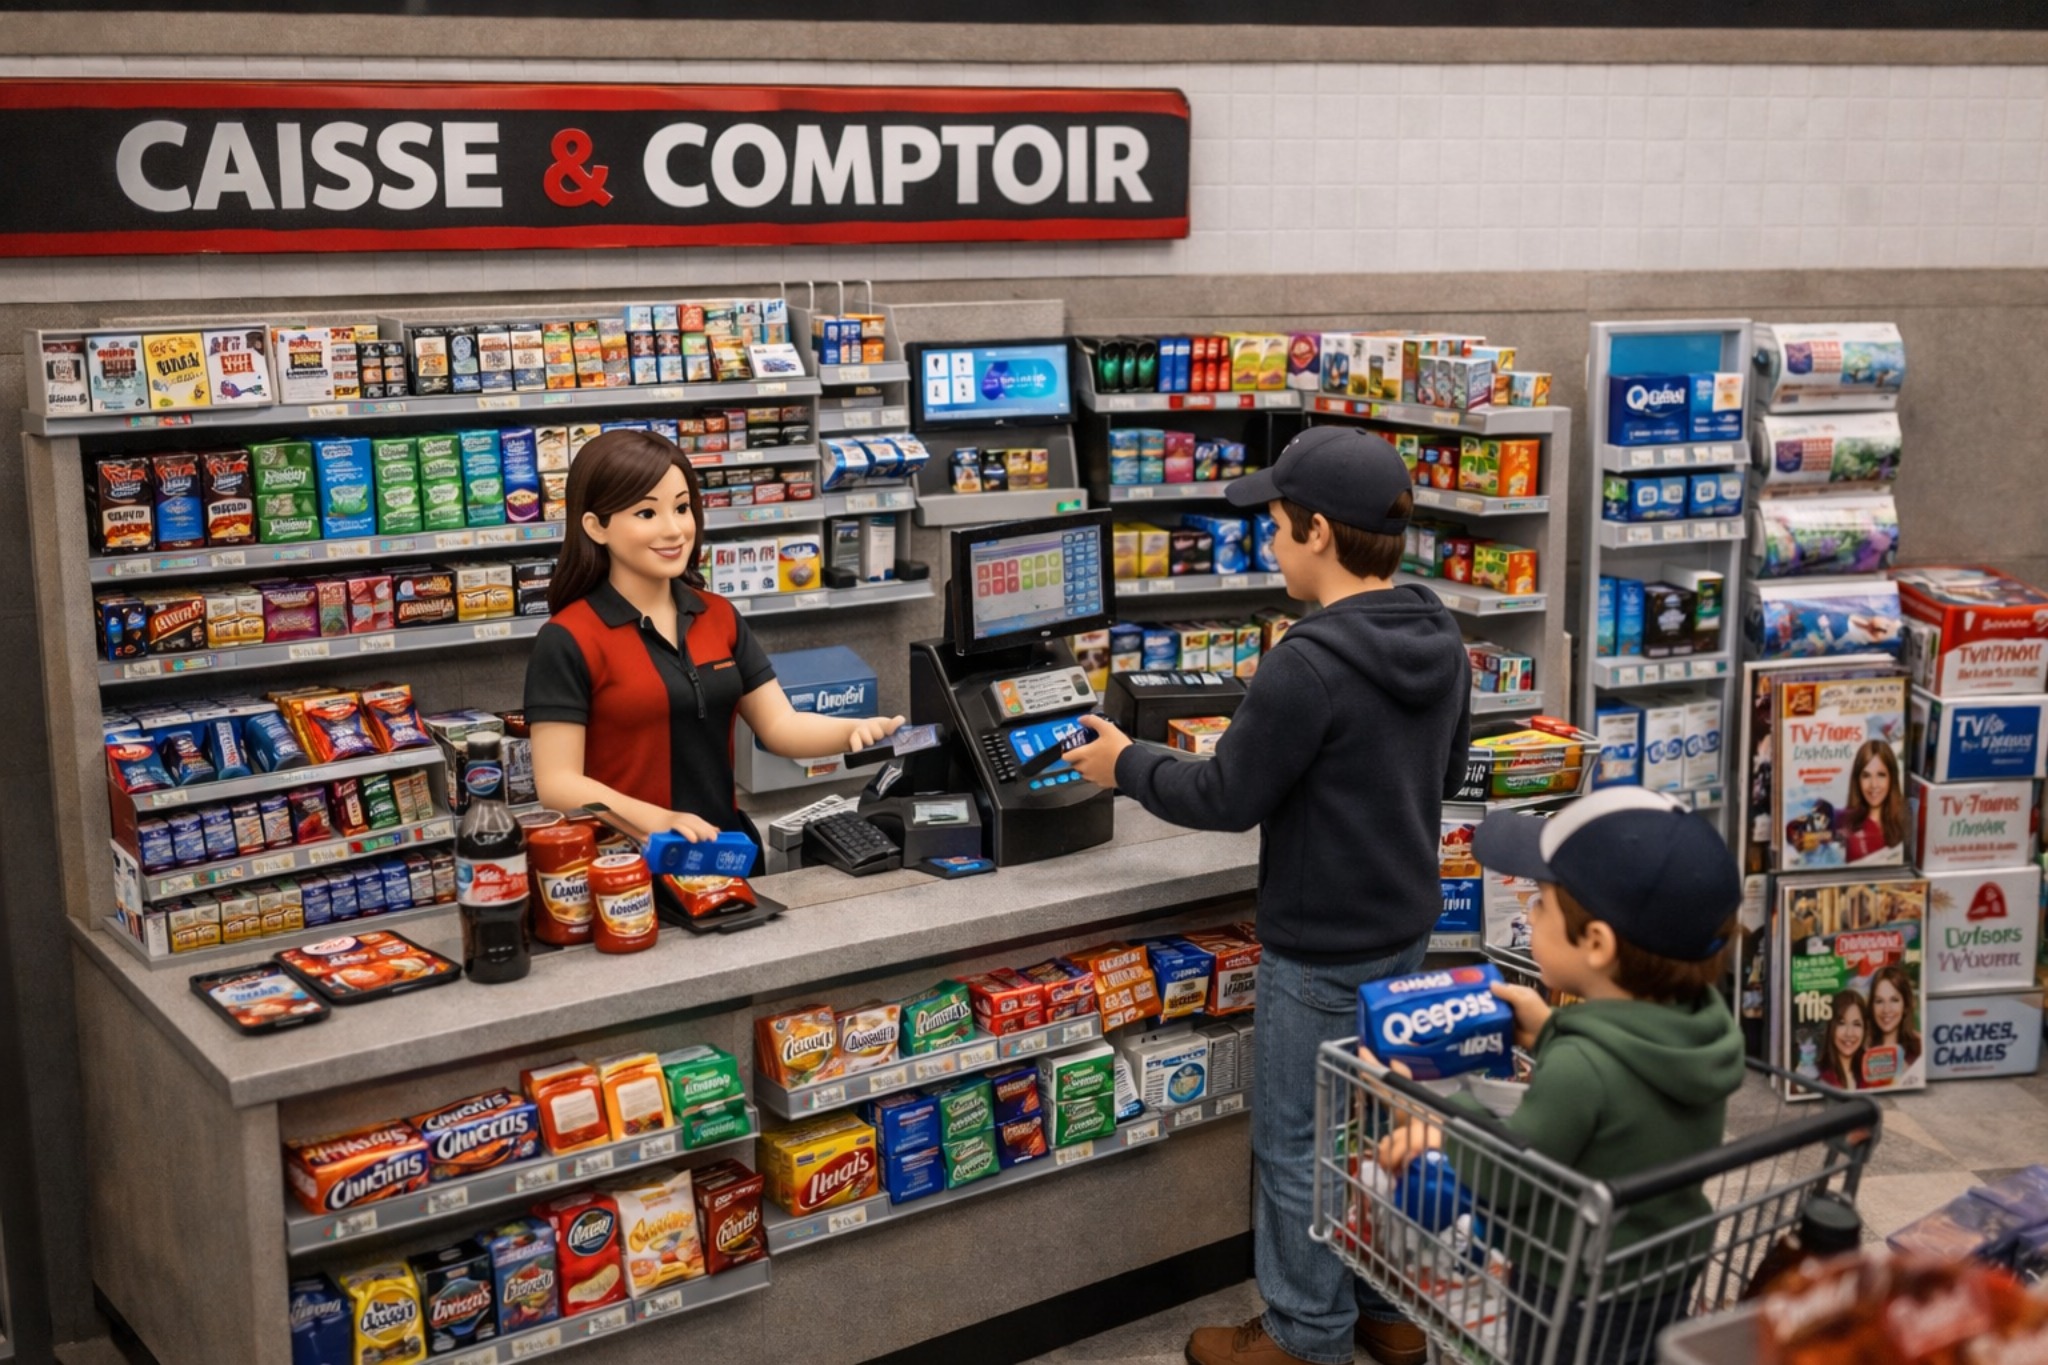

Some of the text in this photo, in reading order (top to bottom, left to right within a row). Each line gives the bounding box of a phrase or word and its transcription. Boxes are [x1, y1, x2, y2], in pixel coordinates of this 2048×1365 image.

[115, 120, 1153, 212] CAISSE & COMPTOIR
